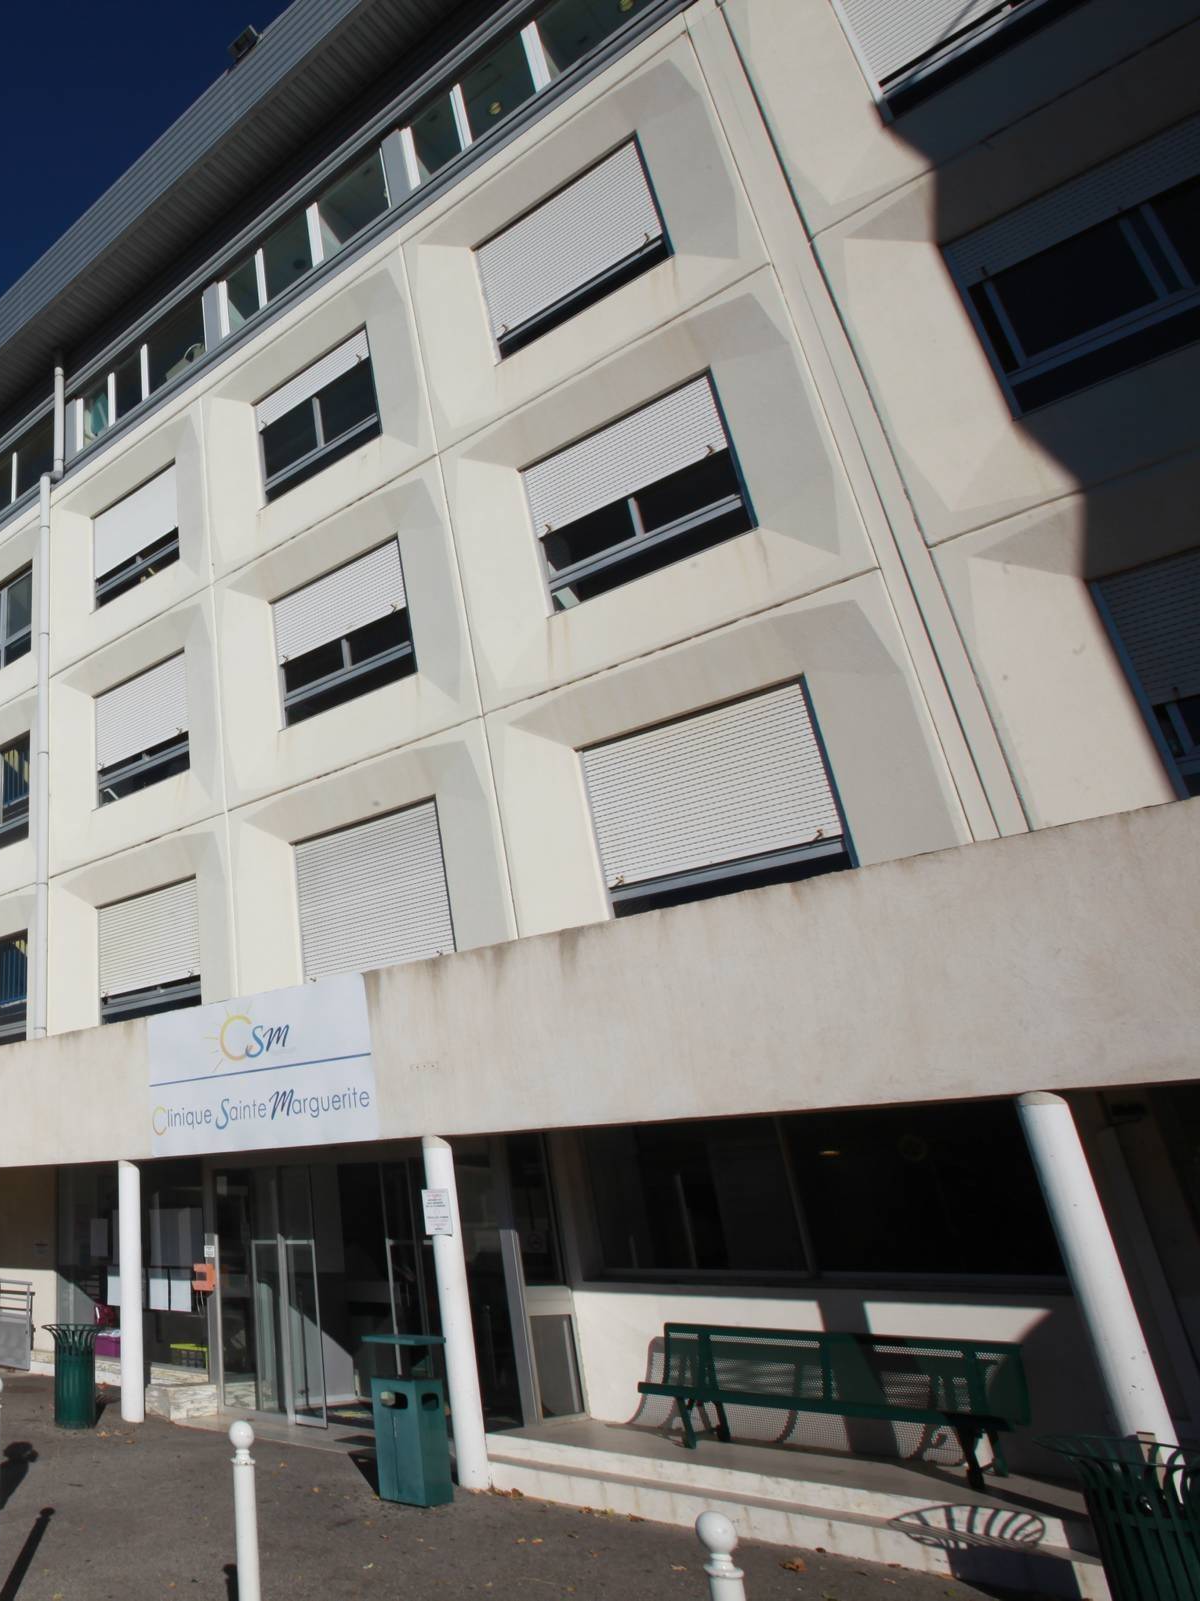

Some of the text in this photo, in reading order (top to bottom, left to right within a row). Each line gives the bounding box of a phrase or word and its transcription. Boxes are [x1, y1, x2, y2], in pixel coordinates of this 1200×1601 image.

[152, 1088, 370, 1136] Clinique Sainte Marguerite
